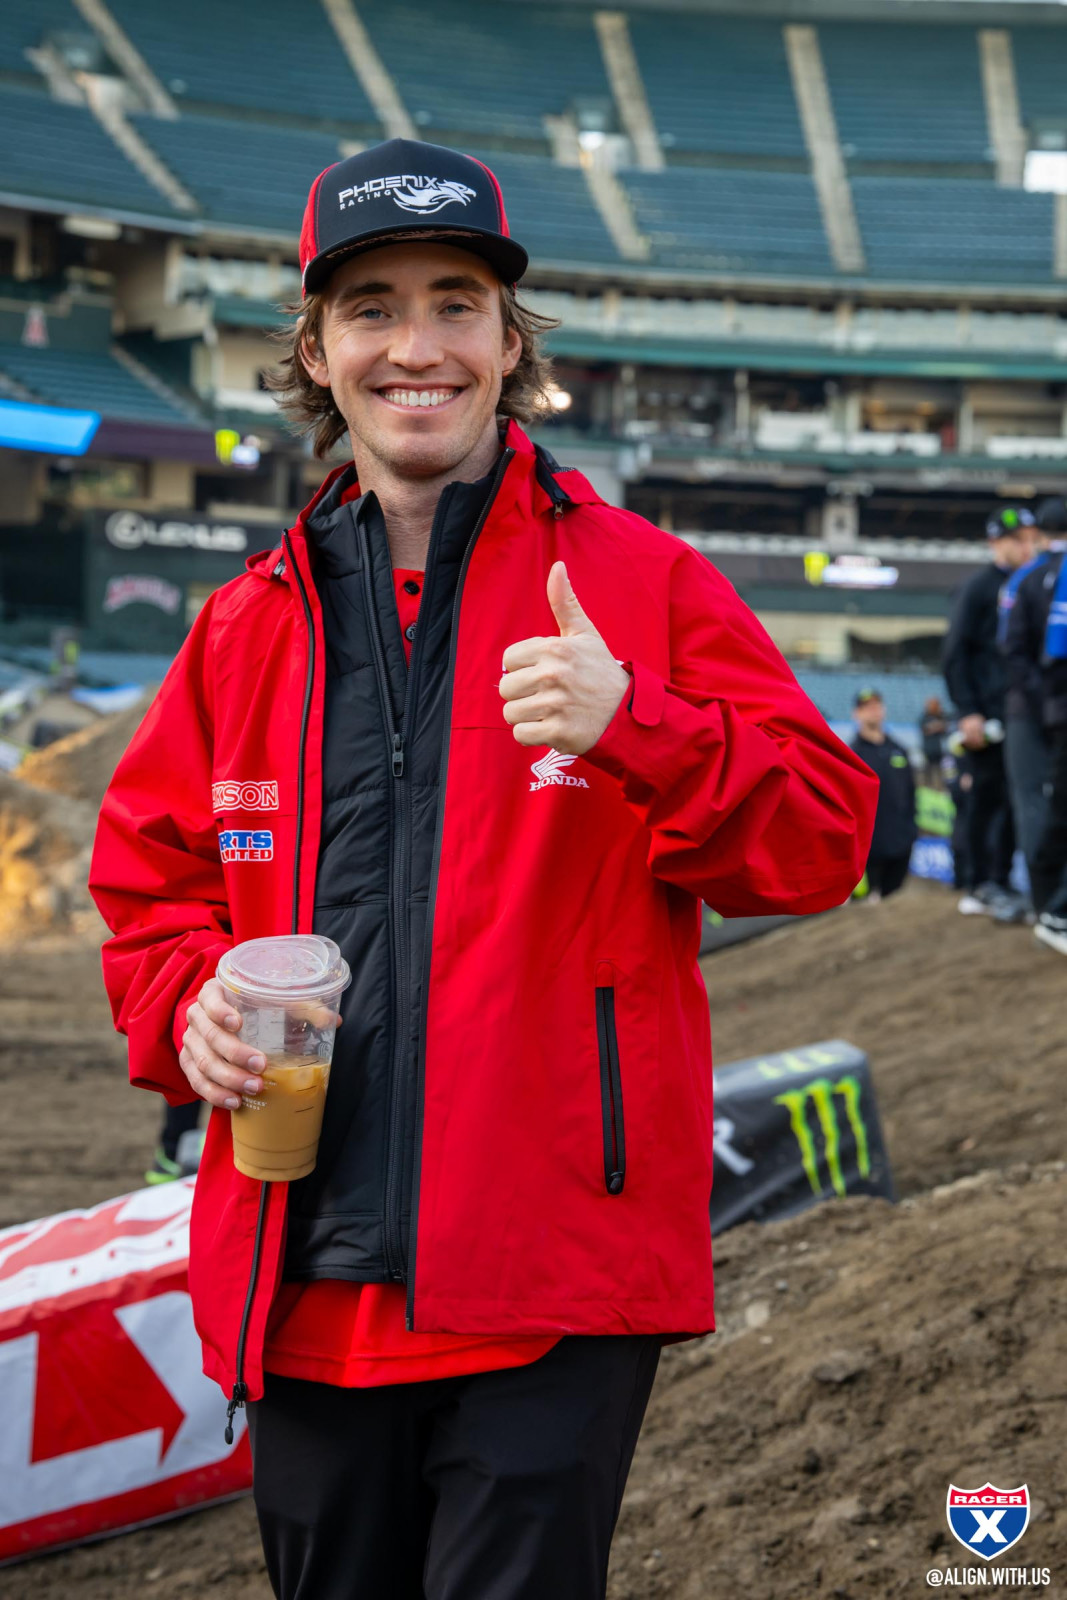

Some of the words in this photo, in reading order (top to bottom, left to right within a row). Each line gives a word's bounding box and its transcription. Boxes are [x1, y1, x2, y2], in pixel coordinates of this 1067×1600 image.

[338, 175, 438, 203] PHOENIX
[339, 190, 392, 211] RACING
[529, 775, 590, 792] HONDA
[212, 780, 279, 813] KSON
[218, 830, 274, 851] RTS
